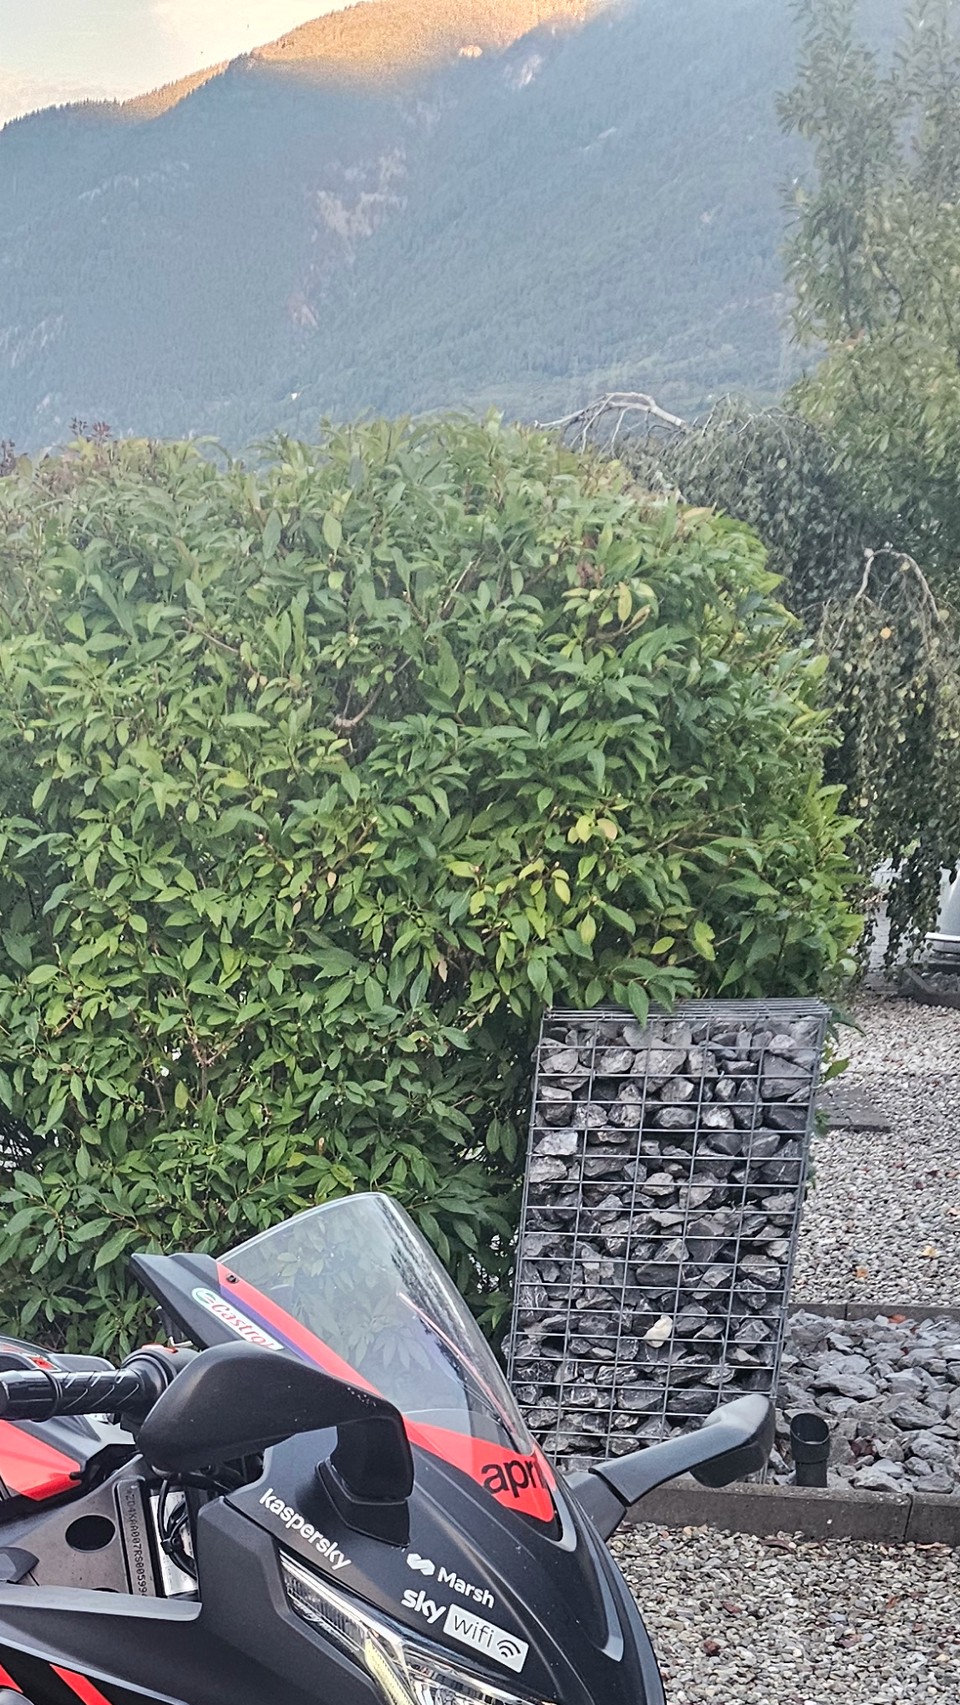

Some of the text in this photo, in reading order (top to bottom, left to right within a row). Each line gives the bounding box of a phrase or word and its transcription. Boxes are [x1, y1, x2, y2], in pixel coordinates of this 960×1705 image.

[211, 1303, 275, 1350] Castrol
[258, 1488, 353, 1571] kaspersky
[437, 1566, 496, 1609] Marsh
[401, 1586, 495, 1647] sky wifi
